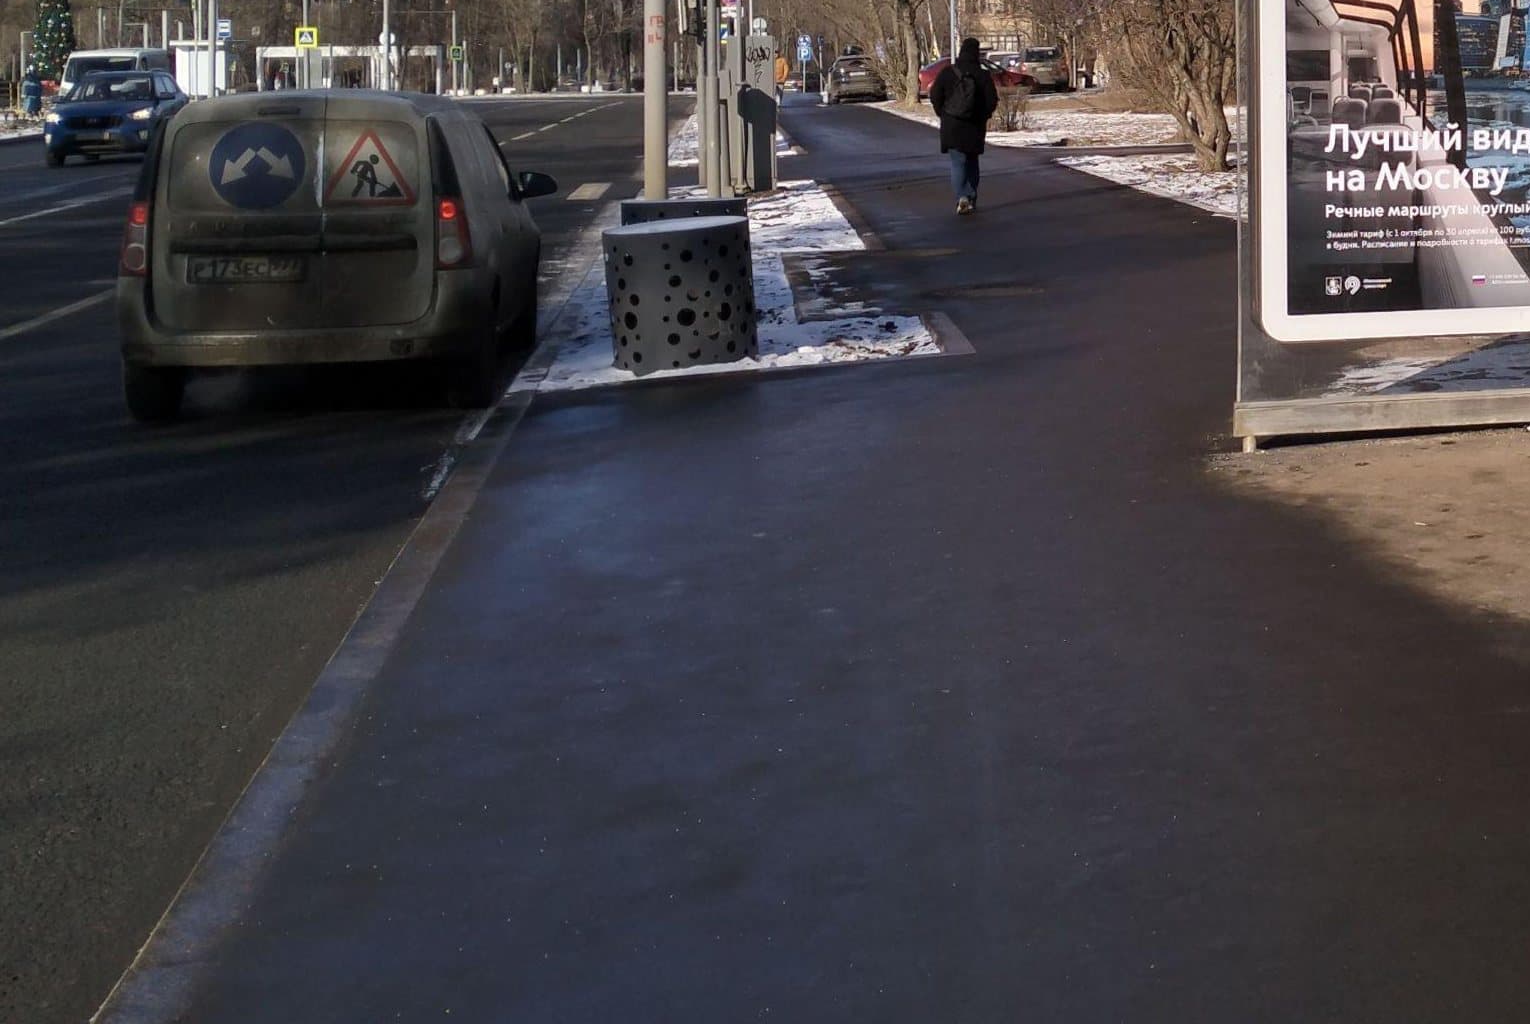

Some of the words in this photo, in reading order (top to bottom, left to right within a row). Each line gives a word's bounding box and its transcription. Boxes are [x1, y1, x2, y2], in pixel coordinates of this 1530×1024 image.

[1324, 123, 1462, 160] Лучший
[1326, 170, 1366, 192] на
[1374, 161, 1509, 195] Москву
[1325, 204, 1385, 218] Речные
[1387, 205, 1469, 220] маршруты
[1359, 229, 1385, 239] тариф
[1400, 228, 1433, 238] октября
[1499, 226, 1514, 234] 100
[1361, 239, 1408, 249] Расписание
[1416, 238, 1468, 249] подробности
